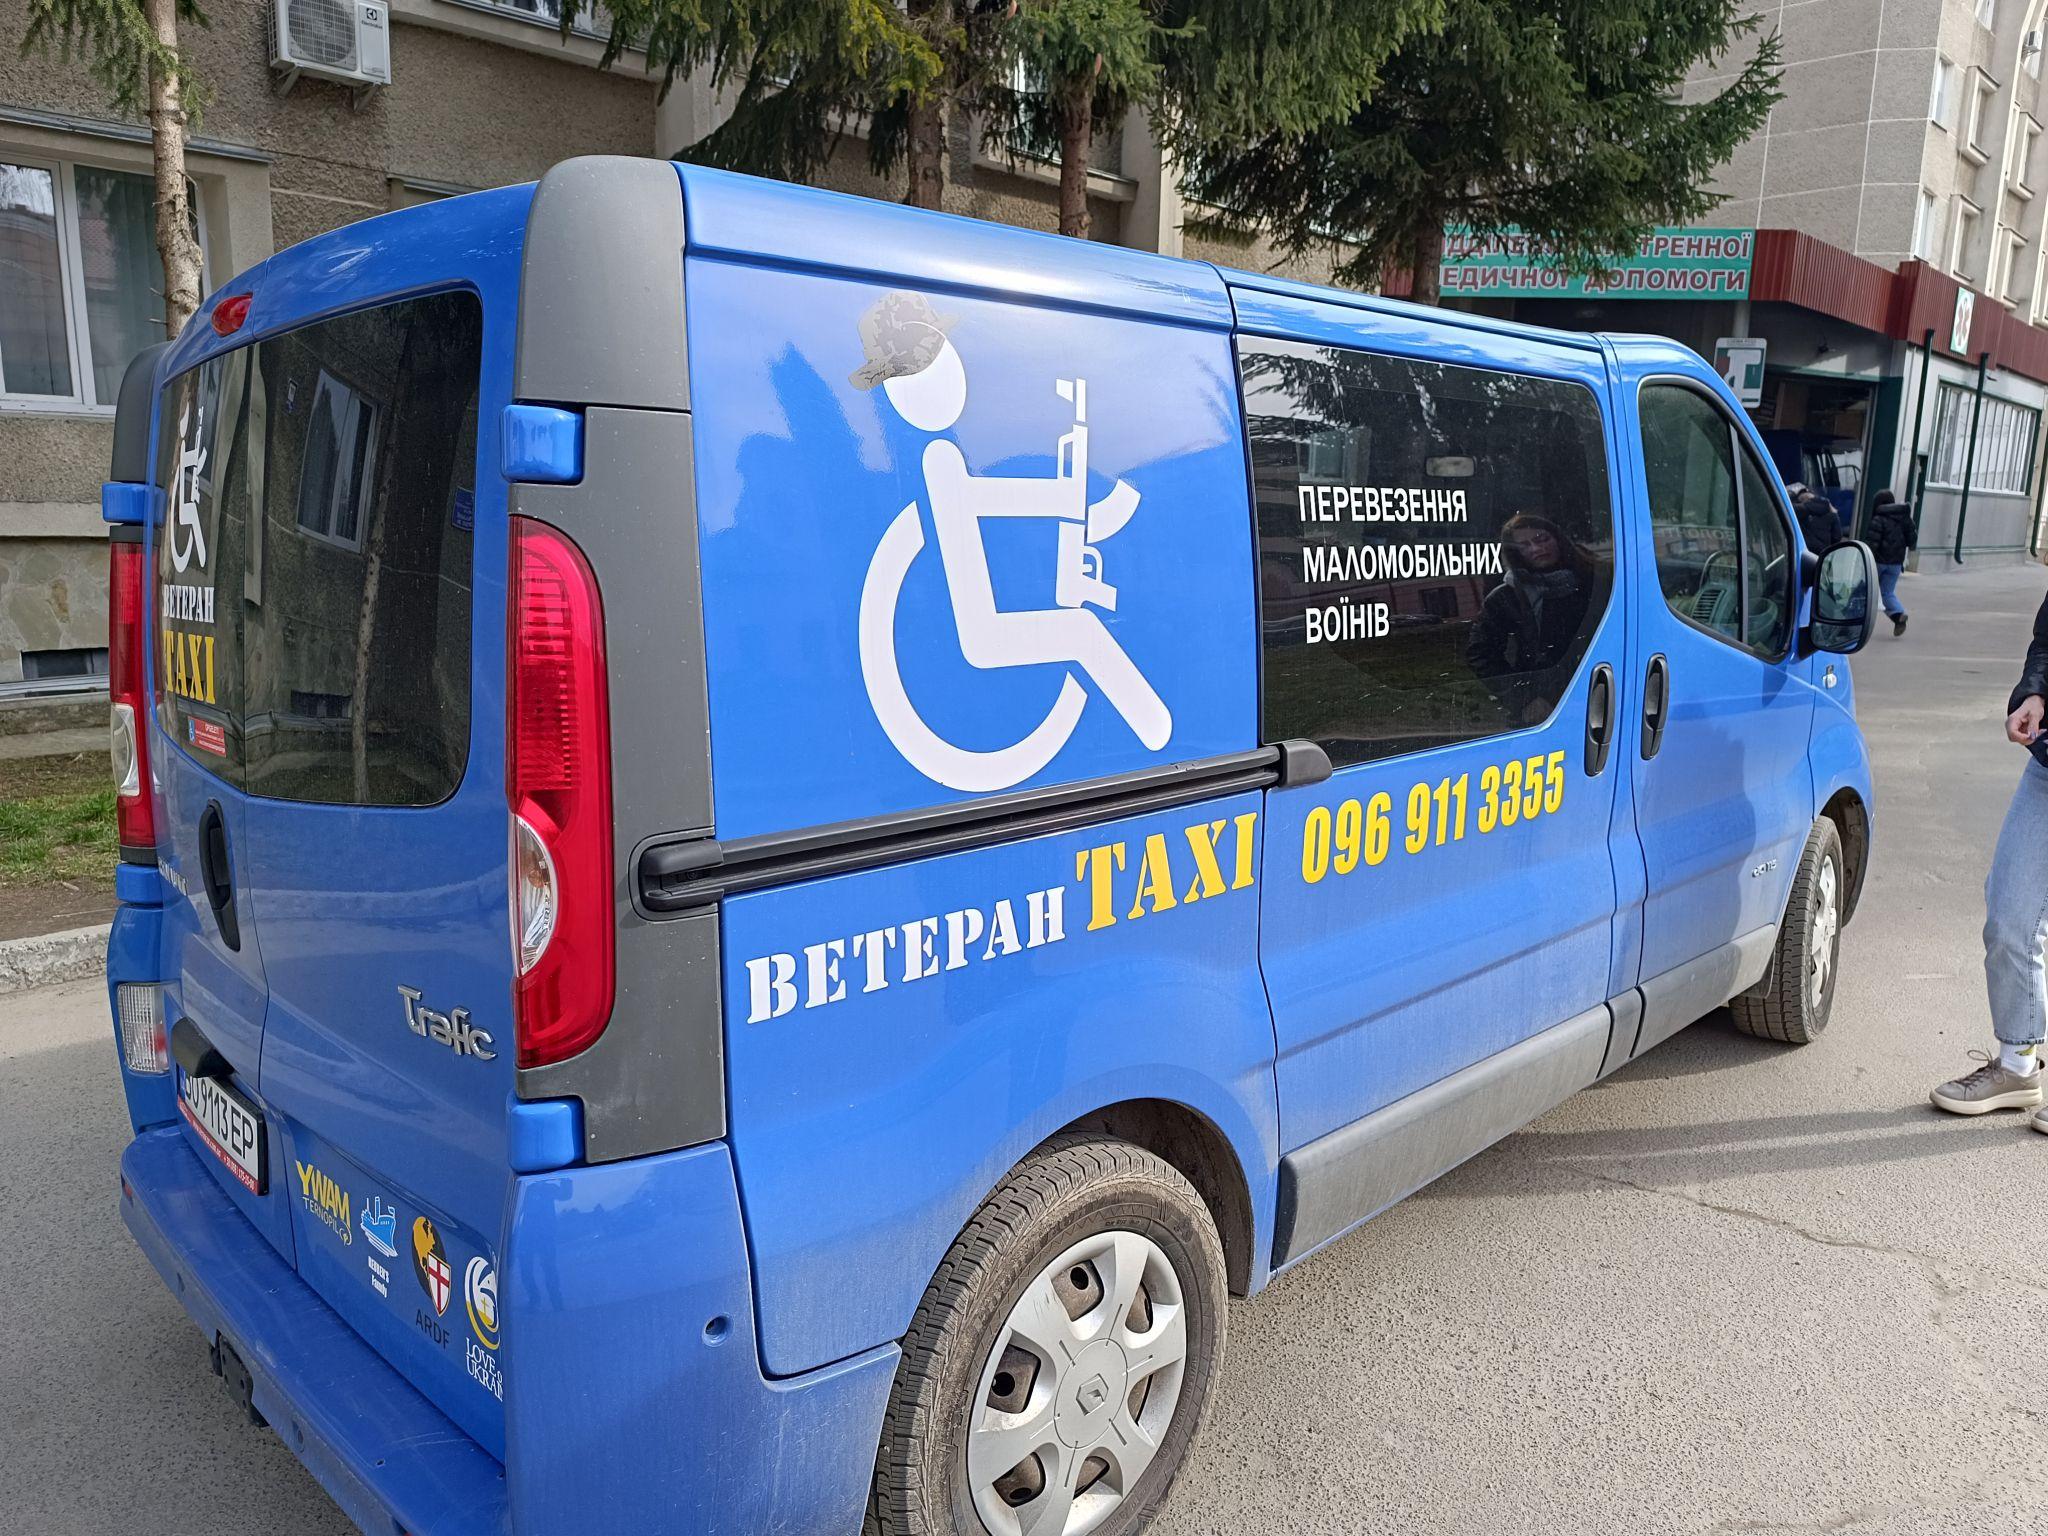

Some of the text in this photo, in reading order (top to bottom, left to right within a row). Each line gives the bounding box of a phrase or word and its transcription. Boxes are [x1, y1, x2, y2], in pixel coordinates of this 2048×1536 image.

[1442, 265, 1569, 291] ЕДИЧНОЇ
[1298, 485, 1468, 523] ПЕРЕВЕЗЕННЯ
[1302, 542, 1503, 583] МАЛОМОБІЛЬНИХ
[163, 583, 215, 624] ВЕТЕРАН
[1305, 597, 1390, 644] ВОЇНІВ
[163, 629, 216, 705] TAXI
[1301, 750, 1565, 884] 096 911 3355
[745, 811, 1259, 1026] ВЕТЕРАН TAXI
[397, 984, 498, 1061] Trafic
[201, 1078, 229, 1141] 9113
[231, 1105, 254, 1160] EP
[295, 1160, 351, 1229] YWAM
[302, 1196, 340, 1235] TERNOPIL
[415, 1308, 451, 1351] ARDF
[465, 1336, 497, 1378] LOVE
